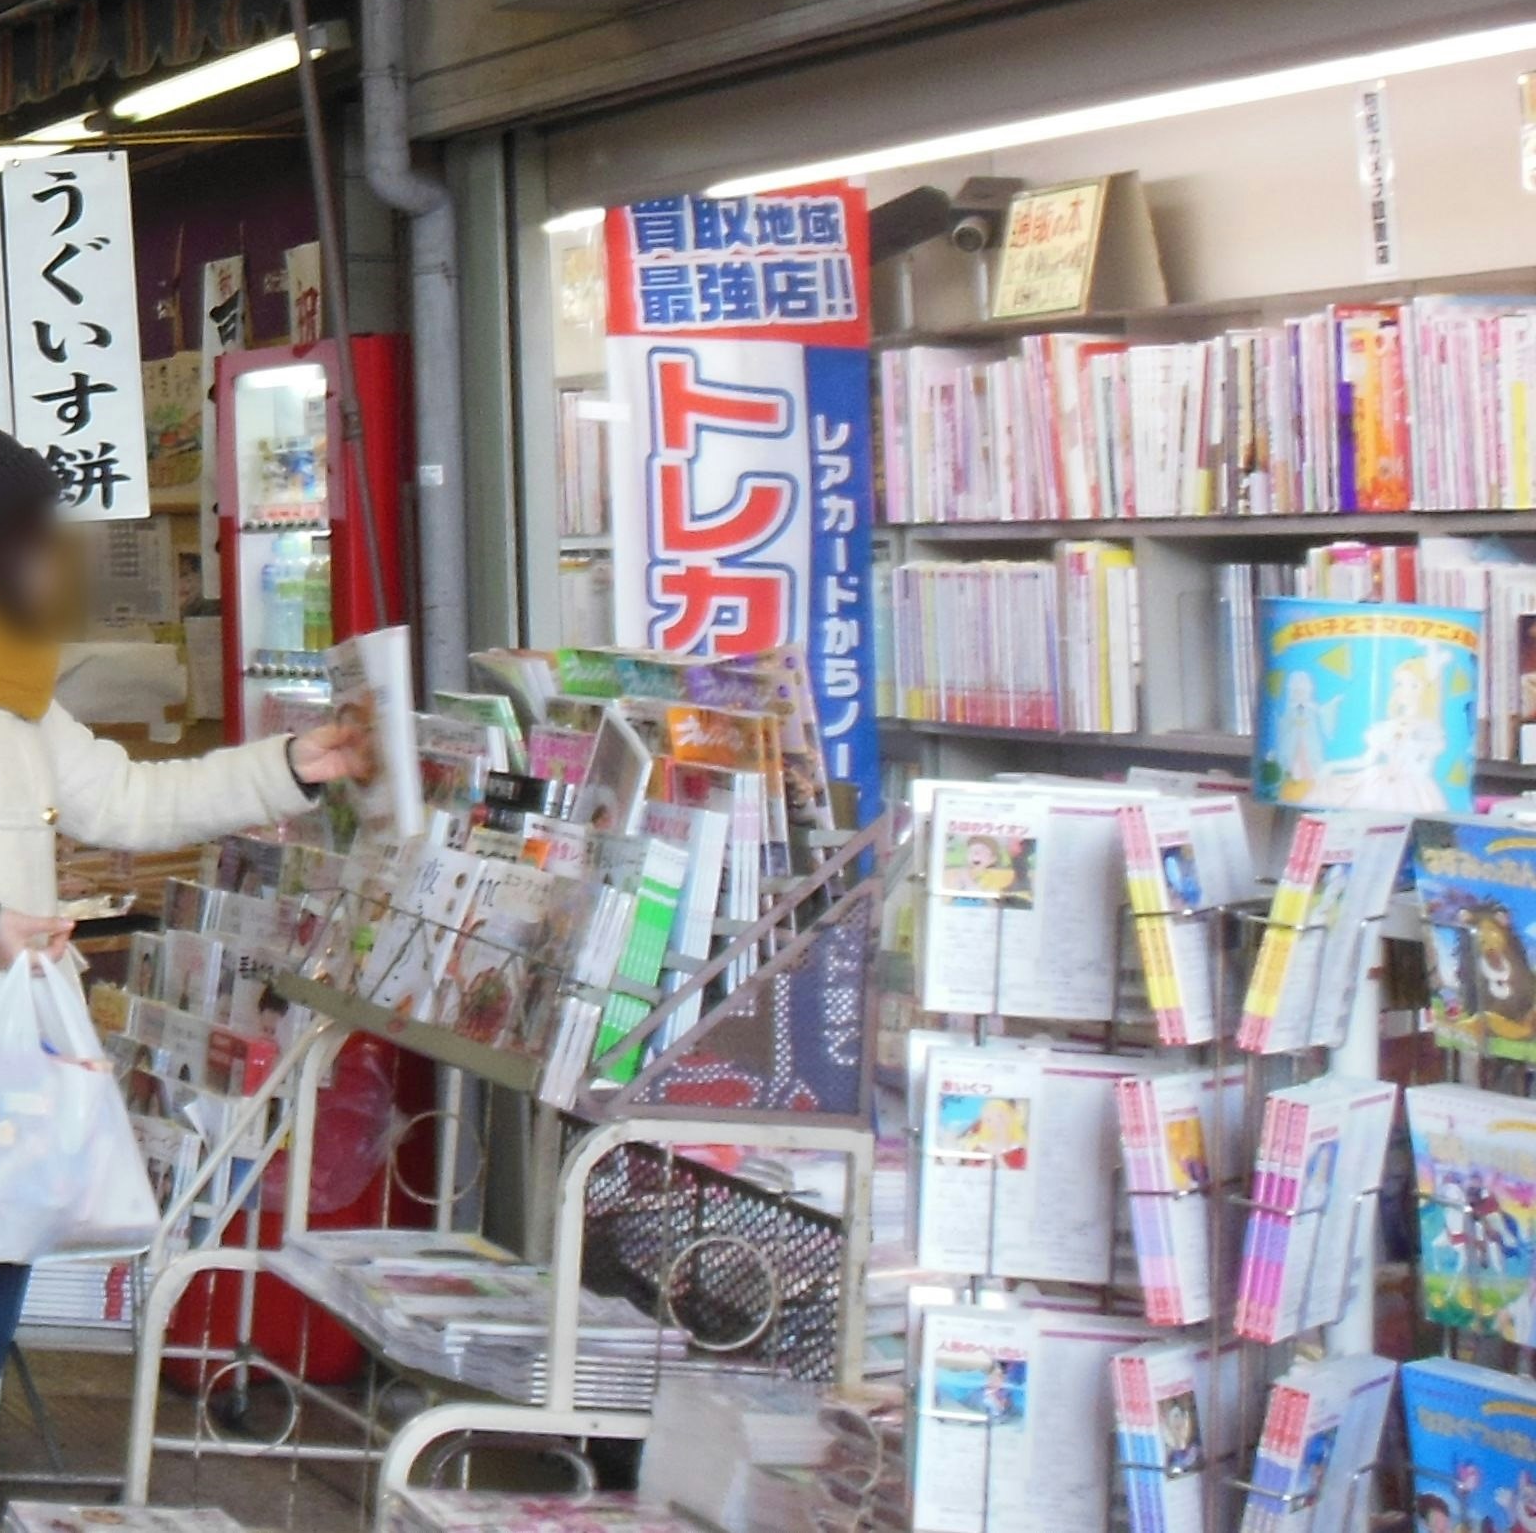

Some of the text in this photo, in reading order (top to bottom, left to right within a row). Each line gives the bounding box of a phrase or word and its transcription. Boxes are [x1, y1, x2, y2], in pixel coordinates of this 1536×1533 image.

[631, 195, 841, 255] 買取地域
[637, 257, 858, 325] 最強店!!
[29, 170, 132, 512] うぐいす餅
[647, 348, 794, 657] トレカ
